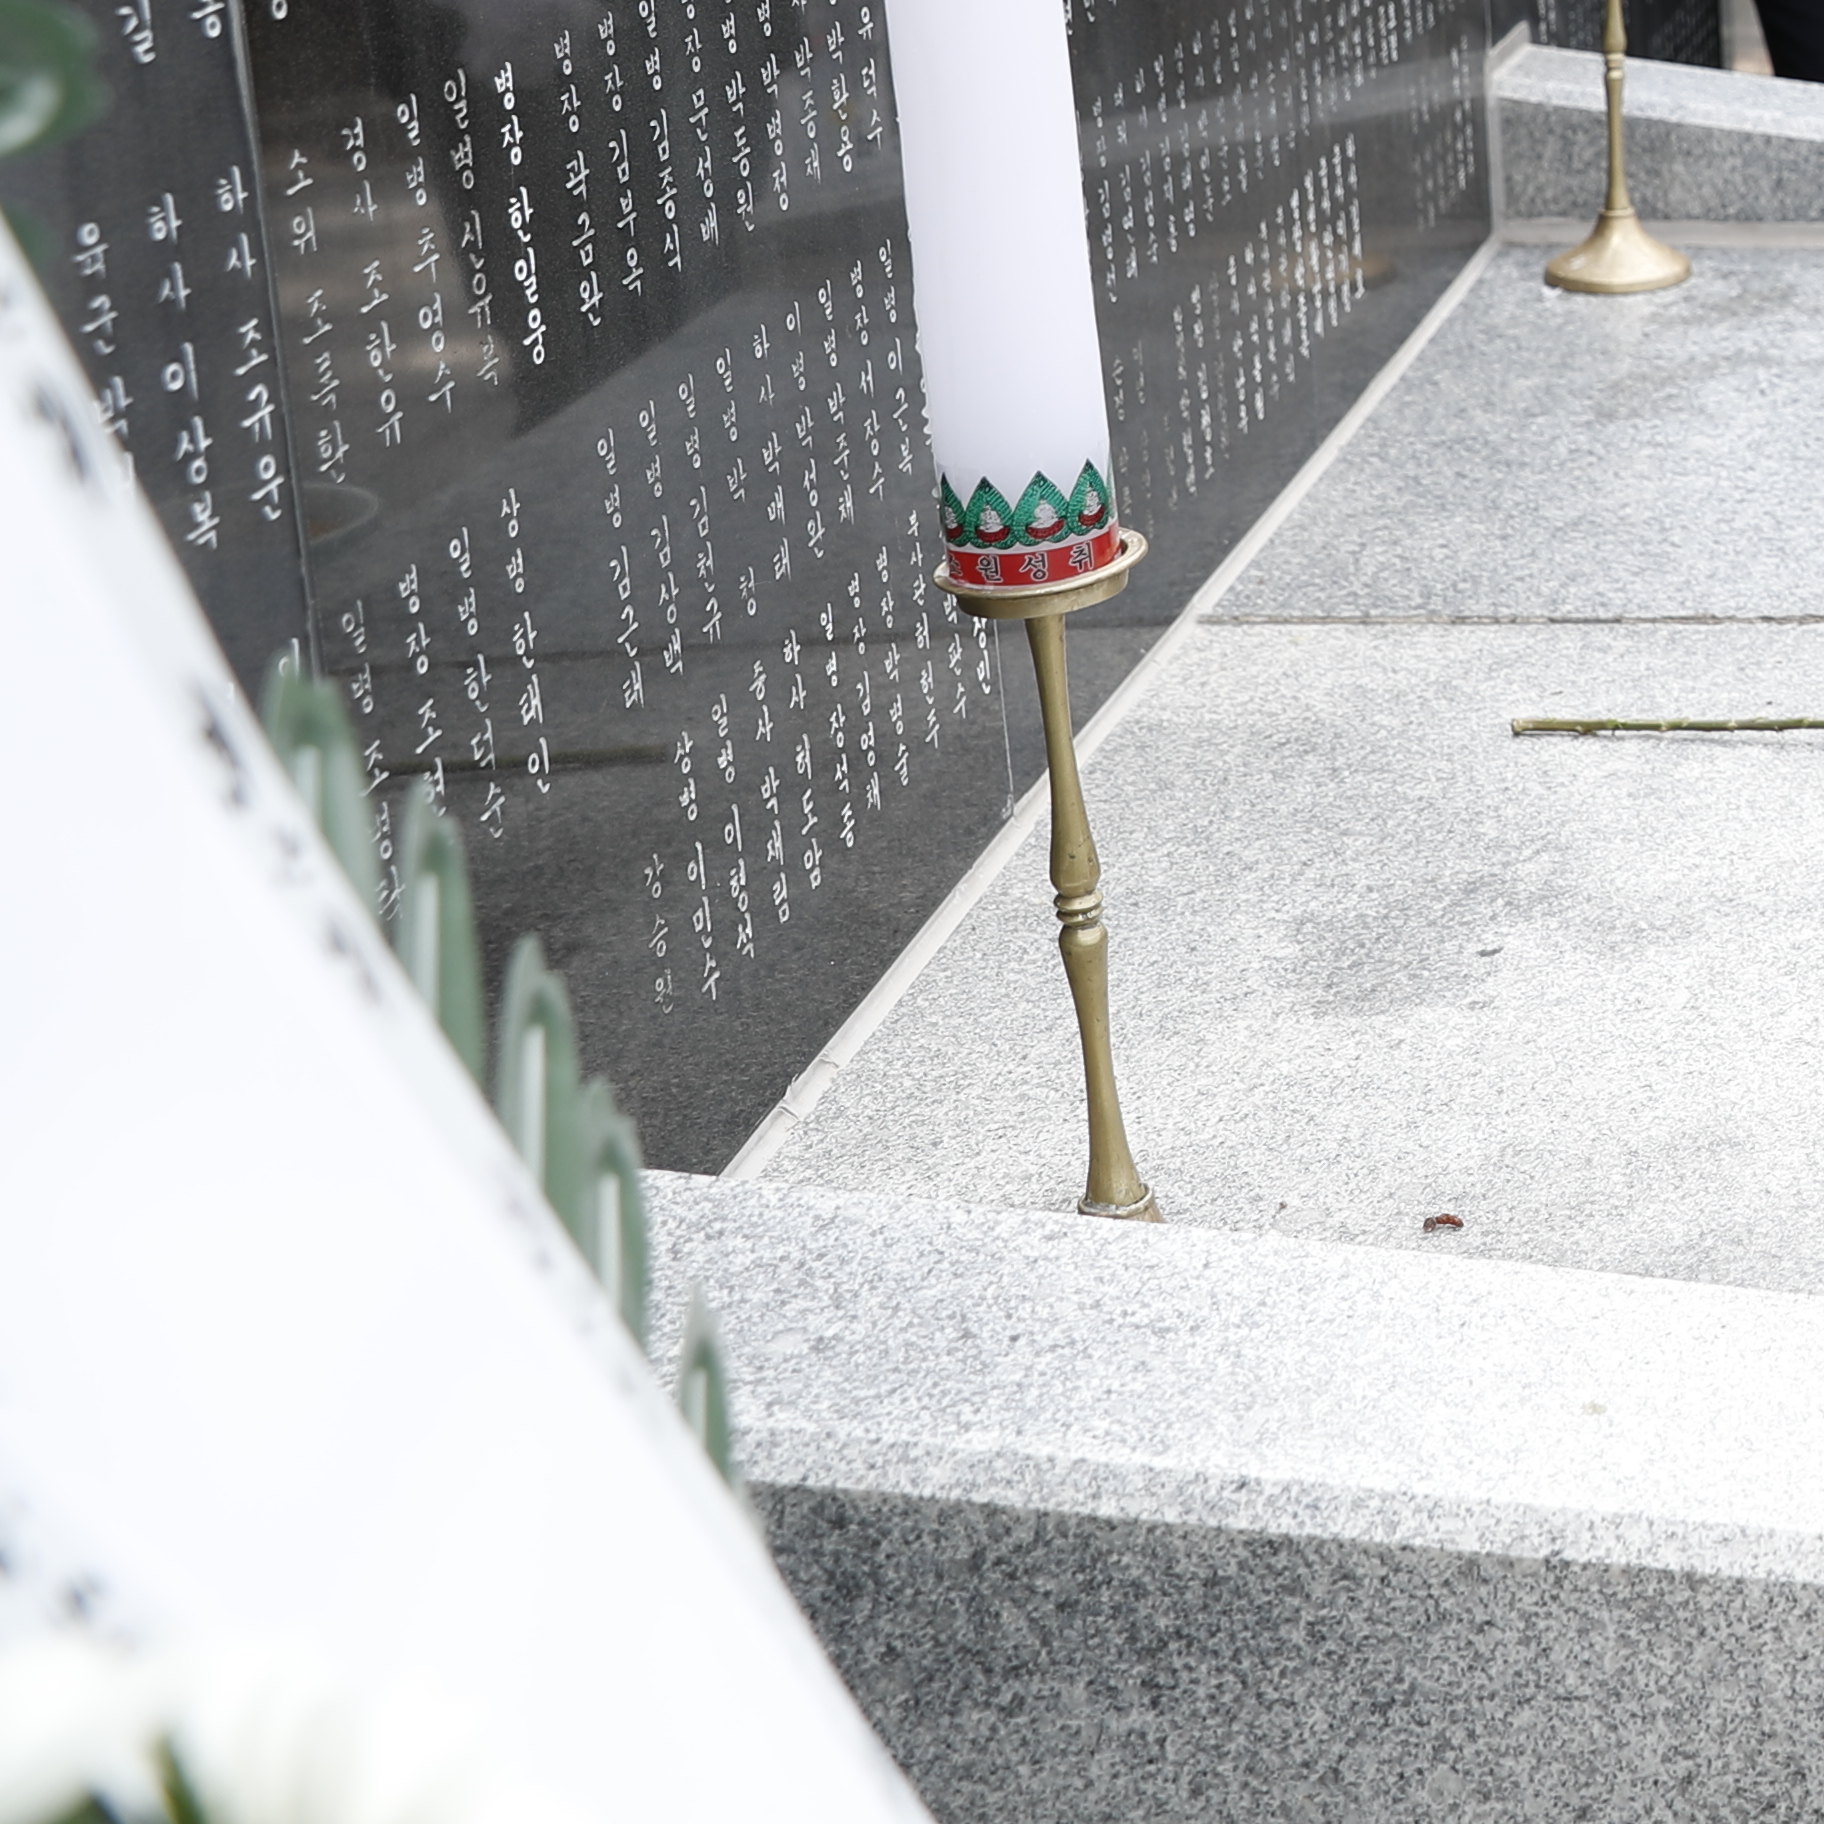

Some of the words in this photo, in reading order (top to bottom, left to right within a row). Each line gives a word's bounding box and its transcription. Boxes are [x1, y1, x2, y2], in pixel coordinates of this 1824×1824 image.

[395, 92, 428, 207] 일병
[493, 60, 524, 167] 병장
[553, 29, 582, 134] 병장
[760, 52, 790, 212] 박병정
[793, 36, 822, 183] 박종재
[826, 20, 854, 173] 박환용
[857, 5, 884, 149] 유덕수
[215, 164, 257, 280] 하사
[649, 107, 682, 273] 김종식
[688, 87, 720, 246] 문성배
[724, 70, 756, 233] 박동원
[148, 192, 192, 309] 하사
[340, 116, 378, 221] 경사
[359, 259, 404, 448] 조한유
[507, 185, 547, 366] 한일웅
[565, 149, 604, 327] 곽금완
[849, 259, 870, 346] 병장
[878, 238, 898, 324] 일병
[411, 226, 456, 414] 추영수
[785, 300, 807, 392] 이병
[817, 278, 838, 368] 일병
[162, 341, 221, 549] 이상복
[234, 317, 285, 522] 조규운
[596, 427, 623, 529] 일병
[638, 399, 663, 499] 일병
[677, 373, 702, 470] 일병
[826, 381, 855, 525] 박준채
[859, 358, 886, 501] 서장수
[886, 336, 914, 476] 이근복
[500, 487, 526, 594] 상병
[795, 405, 826, 559] 박성완
[448, 526, 479, 637] 일병
[608, 544, 645, 709] 김근태
[650, 514, 684, 675] 김상백
[689, 485, 723, 644] 김천규
[847, 571, 867, 656] 병장
[463, 652, 506, 840] 한덕순
[511, 610, 551, 795] 한태인
[711, 693, 736, 784] 일병
[819, 602, 839, 688] 일병
[829, 702, 856, 849] 장석종
[855, 670, 882, 812] 김영채
[673, 730, 698, 822] 상병
[686, 840, 721, 1001] 이민수
[723, 803, 755, 959] 이형석
